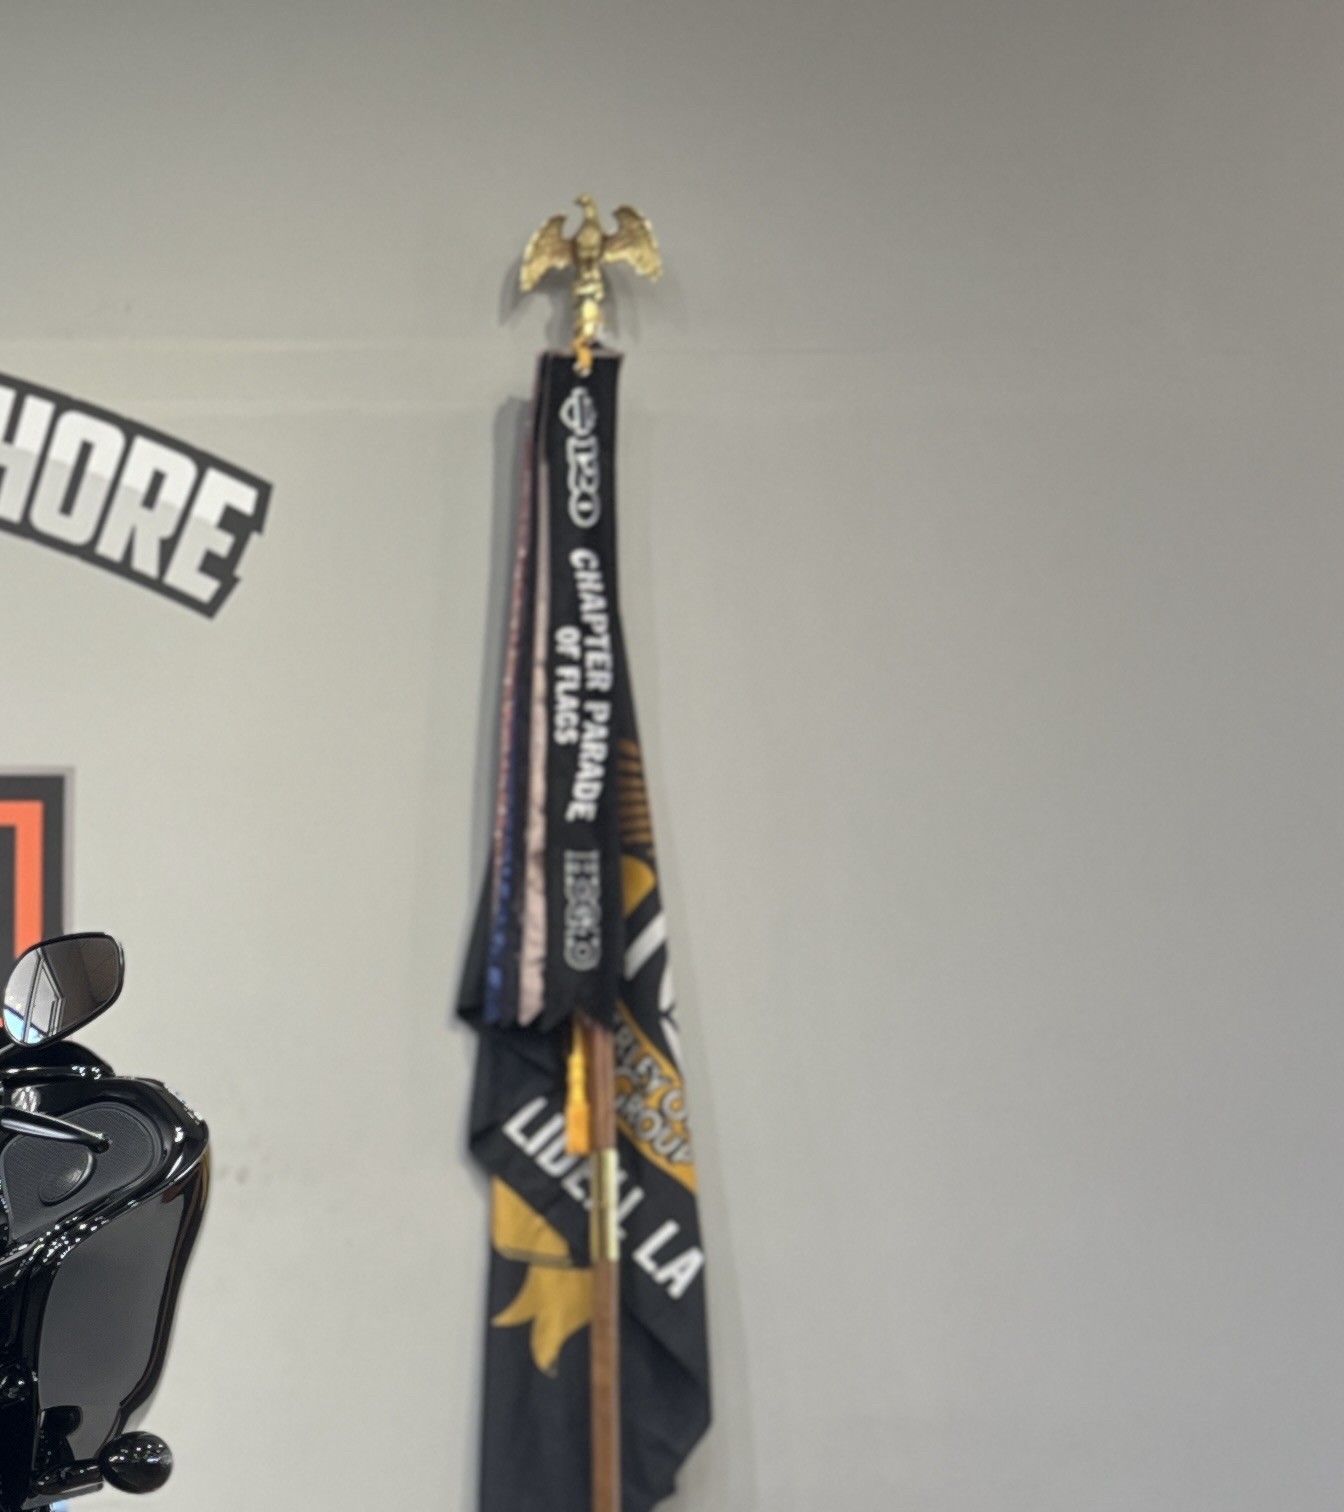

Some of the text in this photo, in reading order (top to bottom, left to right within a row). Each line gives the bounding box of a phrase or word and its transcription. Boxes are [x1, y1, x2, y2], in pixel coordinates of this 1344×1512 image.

[569, 547, 613, 692] CHAPTER
[554, 624, 582, 747] OF FLAGS
[565, 699, 611, 824] PARADE
[632, 1219, 705, 1299] LA
